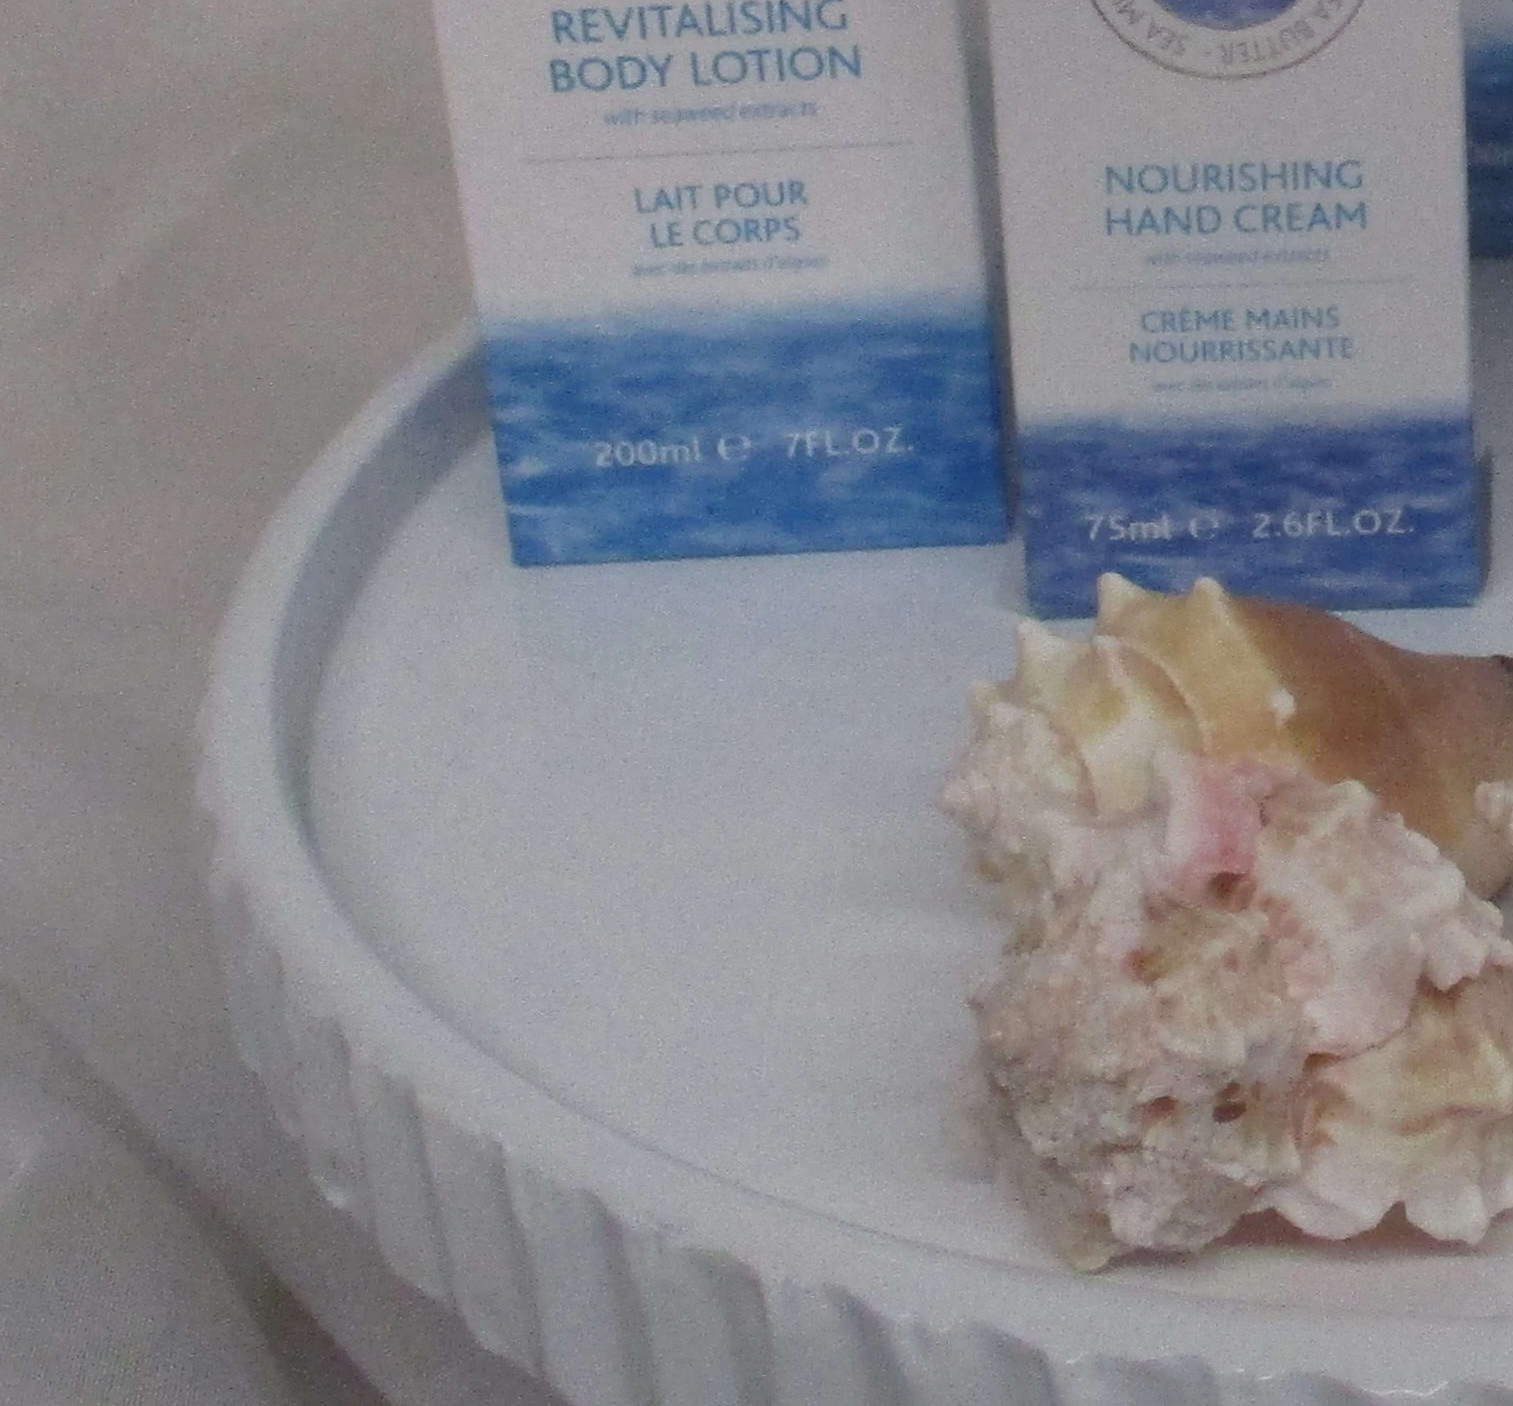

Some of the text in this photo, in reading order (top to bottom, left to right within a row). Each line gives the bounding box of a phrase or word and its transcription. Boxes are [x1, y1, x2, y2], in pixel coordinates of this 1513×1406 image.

[548, 44, 862, 94] BODY LOTION
[1105, 159, 1364, 194] NOURISHING
[634, 179, 809, 215] LAIT POUR
[649, 216, 802, 251] LE CORPS
[1105, 200, 1369, 237] HAND CREAM
[1246, 305, 1341, 331] MAINS
[1129, 336, 1355, 364] NOURRISSANTE
[595, 435, 702, 468] 200ml
[1085, 511, 1173, 541] 75ml
